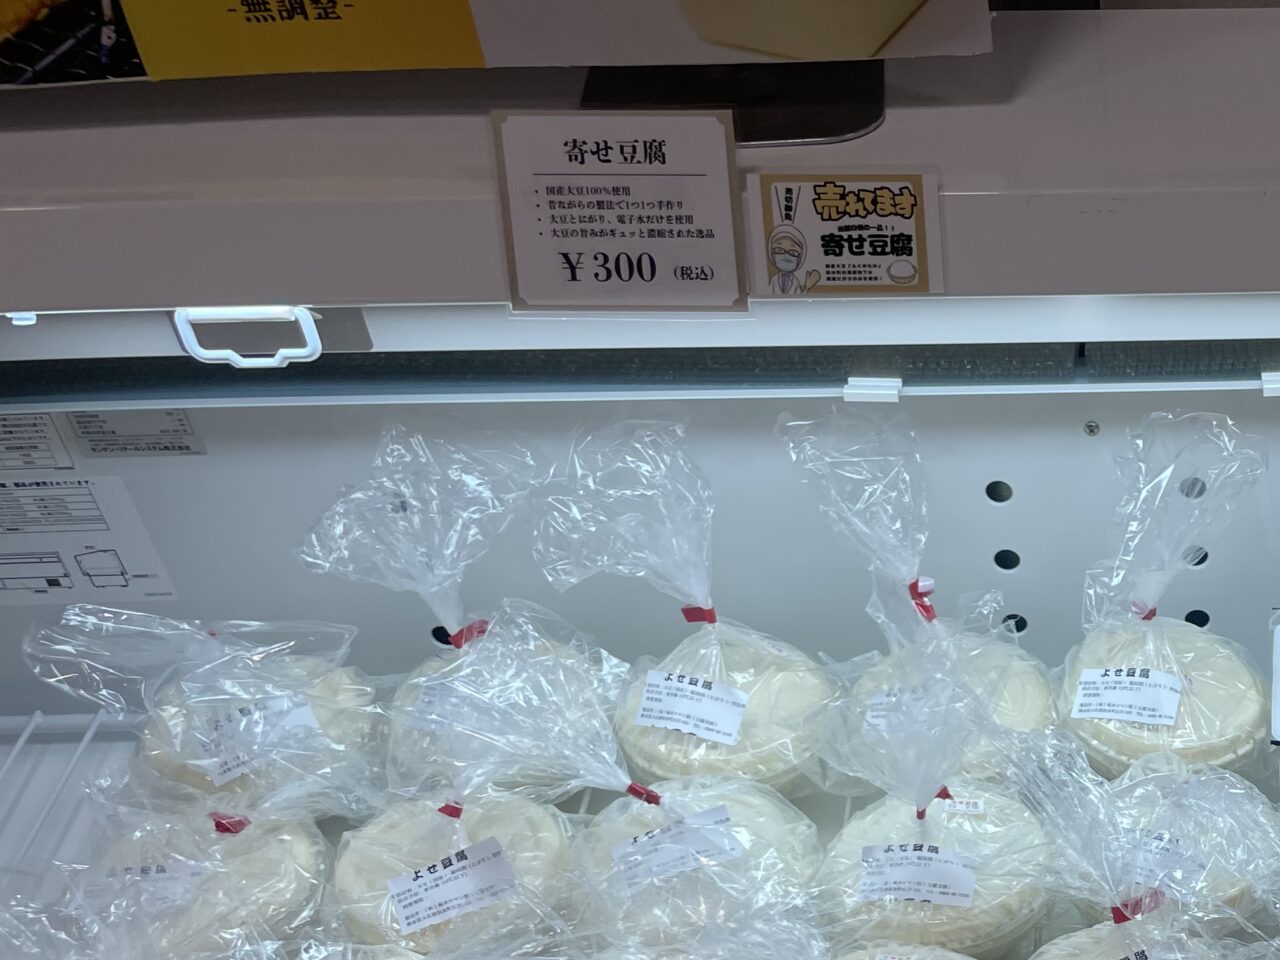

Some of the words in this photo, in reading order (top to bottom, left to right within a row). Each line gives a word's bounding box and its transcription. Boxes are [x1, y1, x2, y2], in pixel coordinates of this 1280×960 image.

[563, 139, 667, 165] 寄せ豆腐
[812, 181, 917, 221] 売れてます
[820, 233, 913, 257] 寄せ豆腐
[664, 673, 713, 690] よせ豆腐
[1101, 668, 1150, 678] よせ豆腐
[412, 850, 468, 881] よせ豆腐
